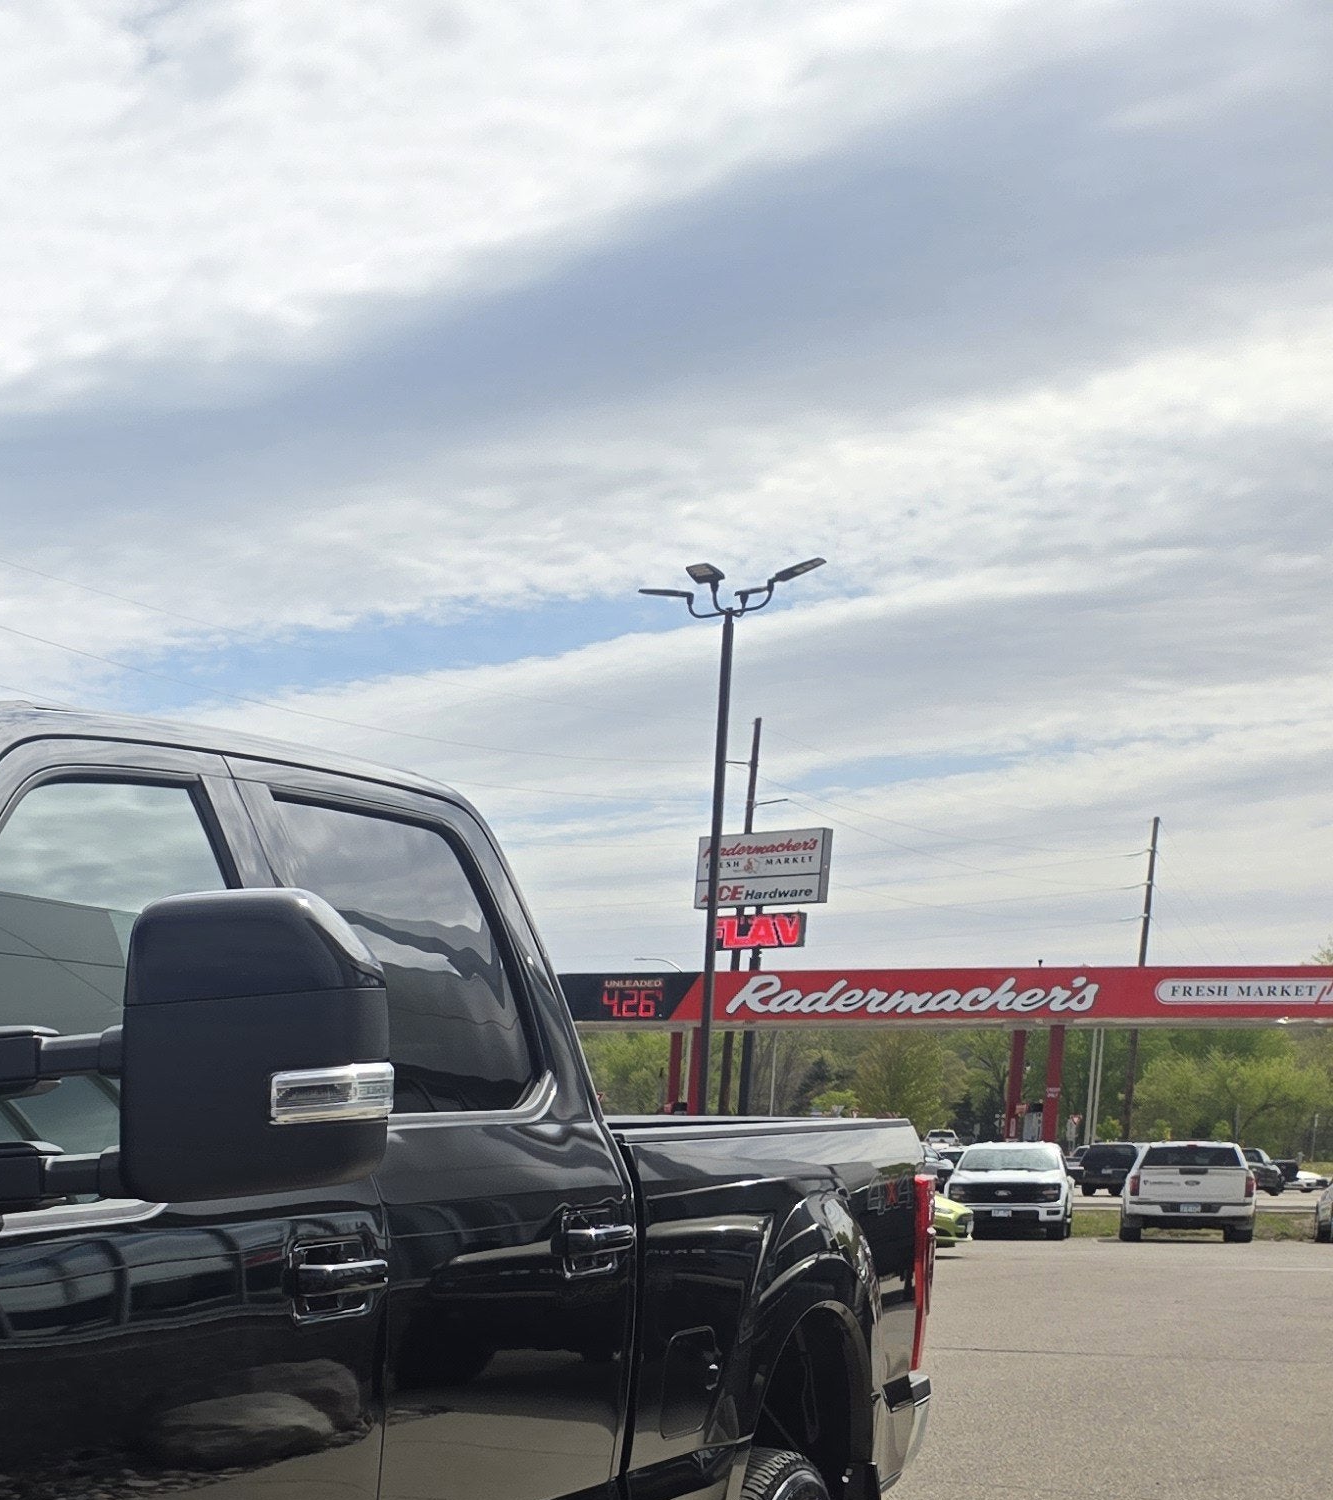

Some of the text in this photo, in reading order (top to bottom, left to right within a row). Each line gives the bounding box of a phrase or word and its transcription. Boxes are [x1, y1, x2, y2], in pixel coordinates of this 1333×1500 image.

[765, 856, 813, 865] MARKET
[745, 888, 813, 900] Hardware
[605, 980, 663, 988] UNLEADED
[726, 975, 1099, 1014] Radermacher's
[1171, 985, 1317, 997] FRESH MARKET
